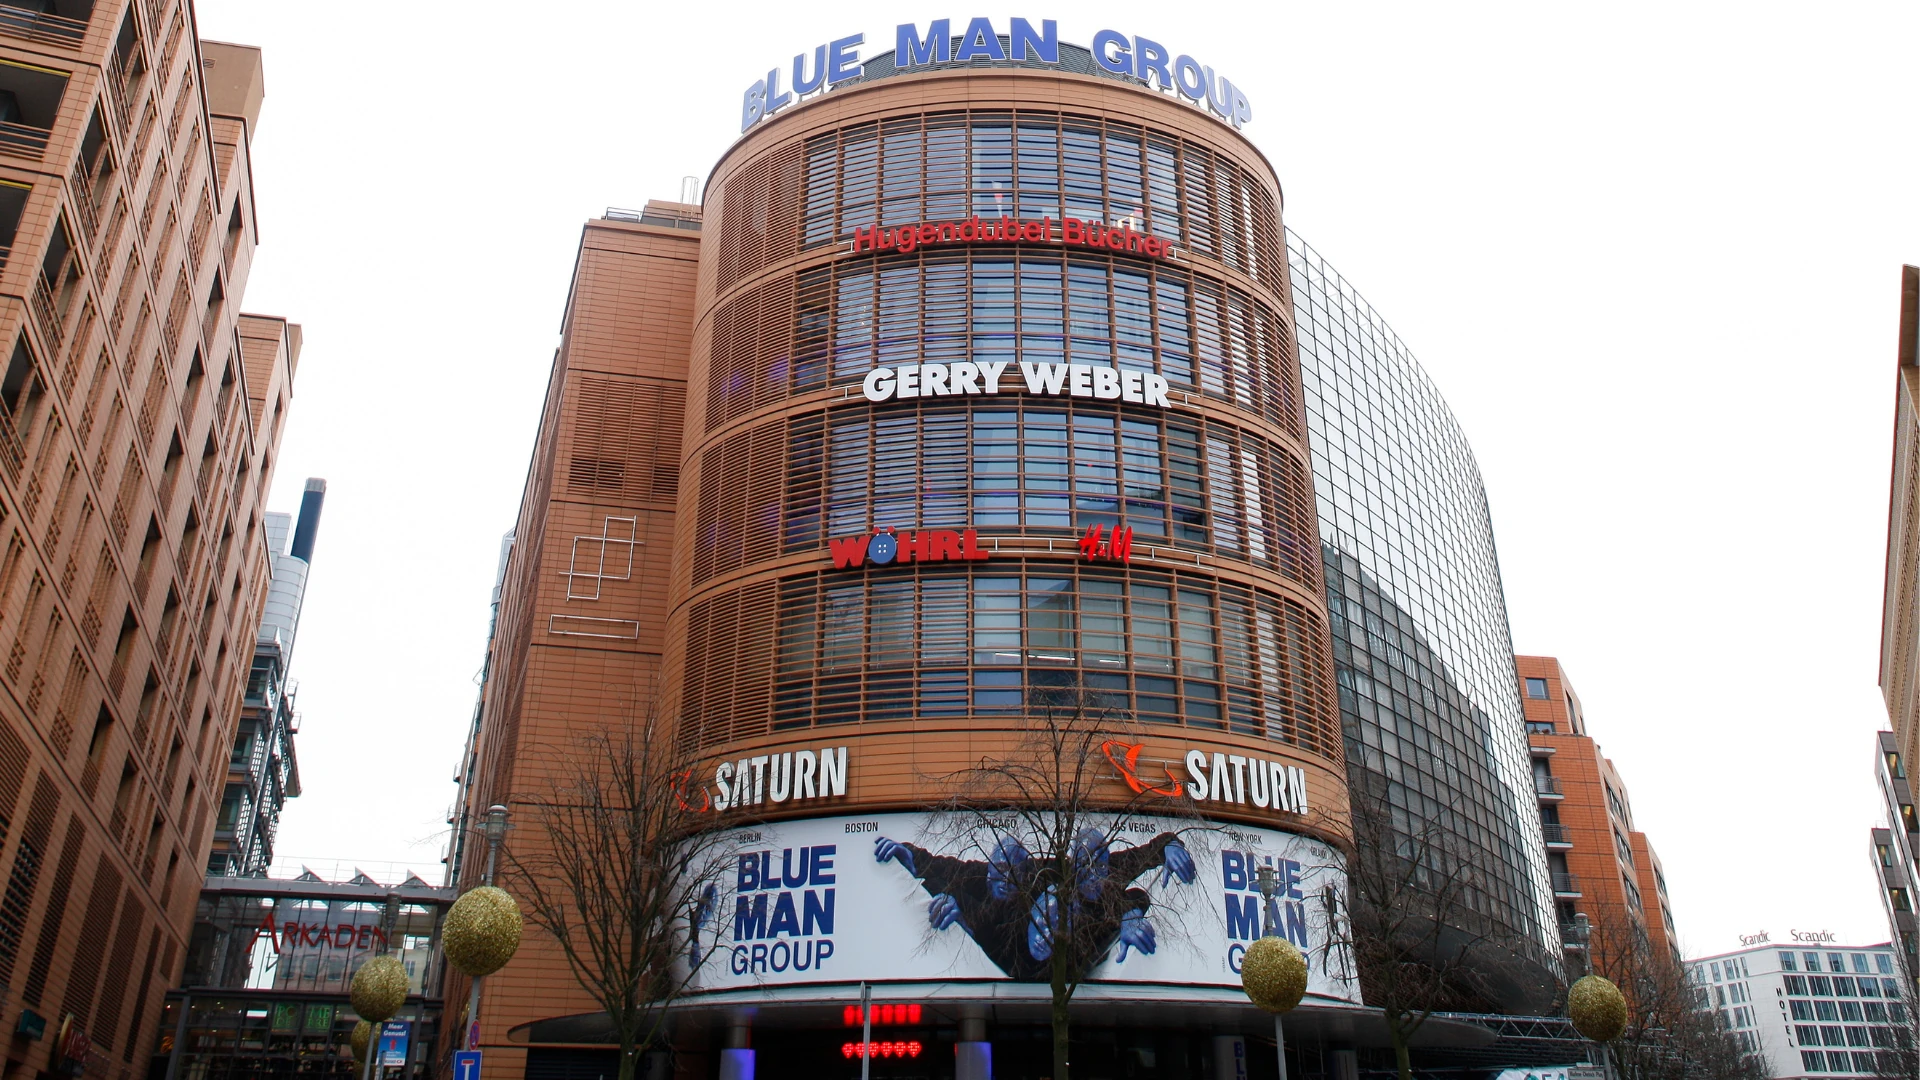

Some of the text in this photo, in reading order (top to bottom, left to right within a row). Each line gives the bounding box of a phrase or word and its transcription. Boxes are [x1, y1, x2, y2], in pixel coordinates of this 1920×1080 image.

[741, 17, 1254, 133] BLUE MAN GROUP
[741, 17, 1254, 133] BLUE MAN GROUP
[854, 215, 1172, 258] Hugendubel Bücher
[863, 361, 1172, 408] GERRY WEBER
[828, 526, 989, 569] WÖHRL
[1078, 523, 1133, 565] H&M
[715, 746, 848, 811] SATURN
[1185, 749, 1308, 815] SATURN
[739, 832, 762, 844] BERLIN
[845, 821, 879, 834] BOSTON
[976, 818, 1017, 830] CHICAGO
[1109, 821, 1156, 834] LAS VEGAS
[1245, 832, 1262, 845] YORK
[1221, 849, 1303, 900] BLUE
[243, 911, 388, 954] ARKADEN
[733, 888, 836, 942] MAN
[1225, 893, 1308, 948] MAN
[1790, 928, 1836, 942] Scandic
[731, 939, 835, 976] GROUP
[1739, 930, 1771, 947] Scandic
[1775, 987, 1794, 1048] HOTEL
[1234, 1041, 1247, 1080] BL
